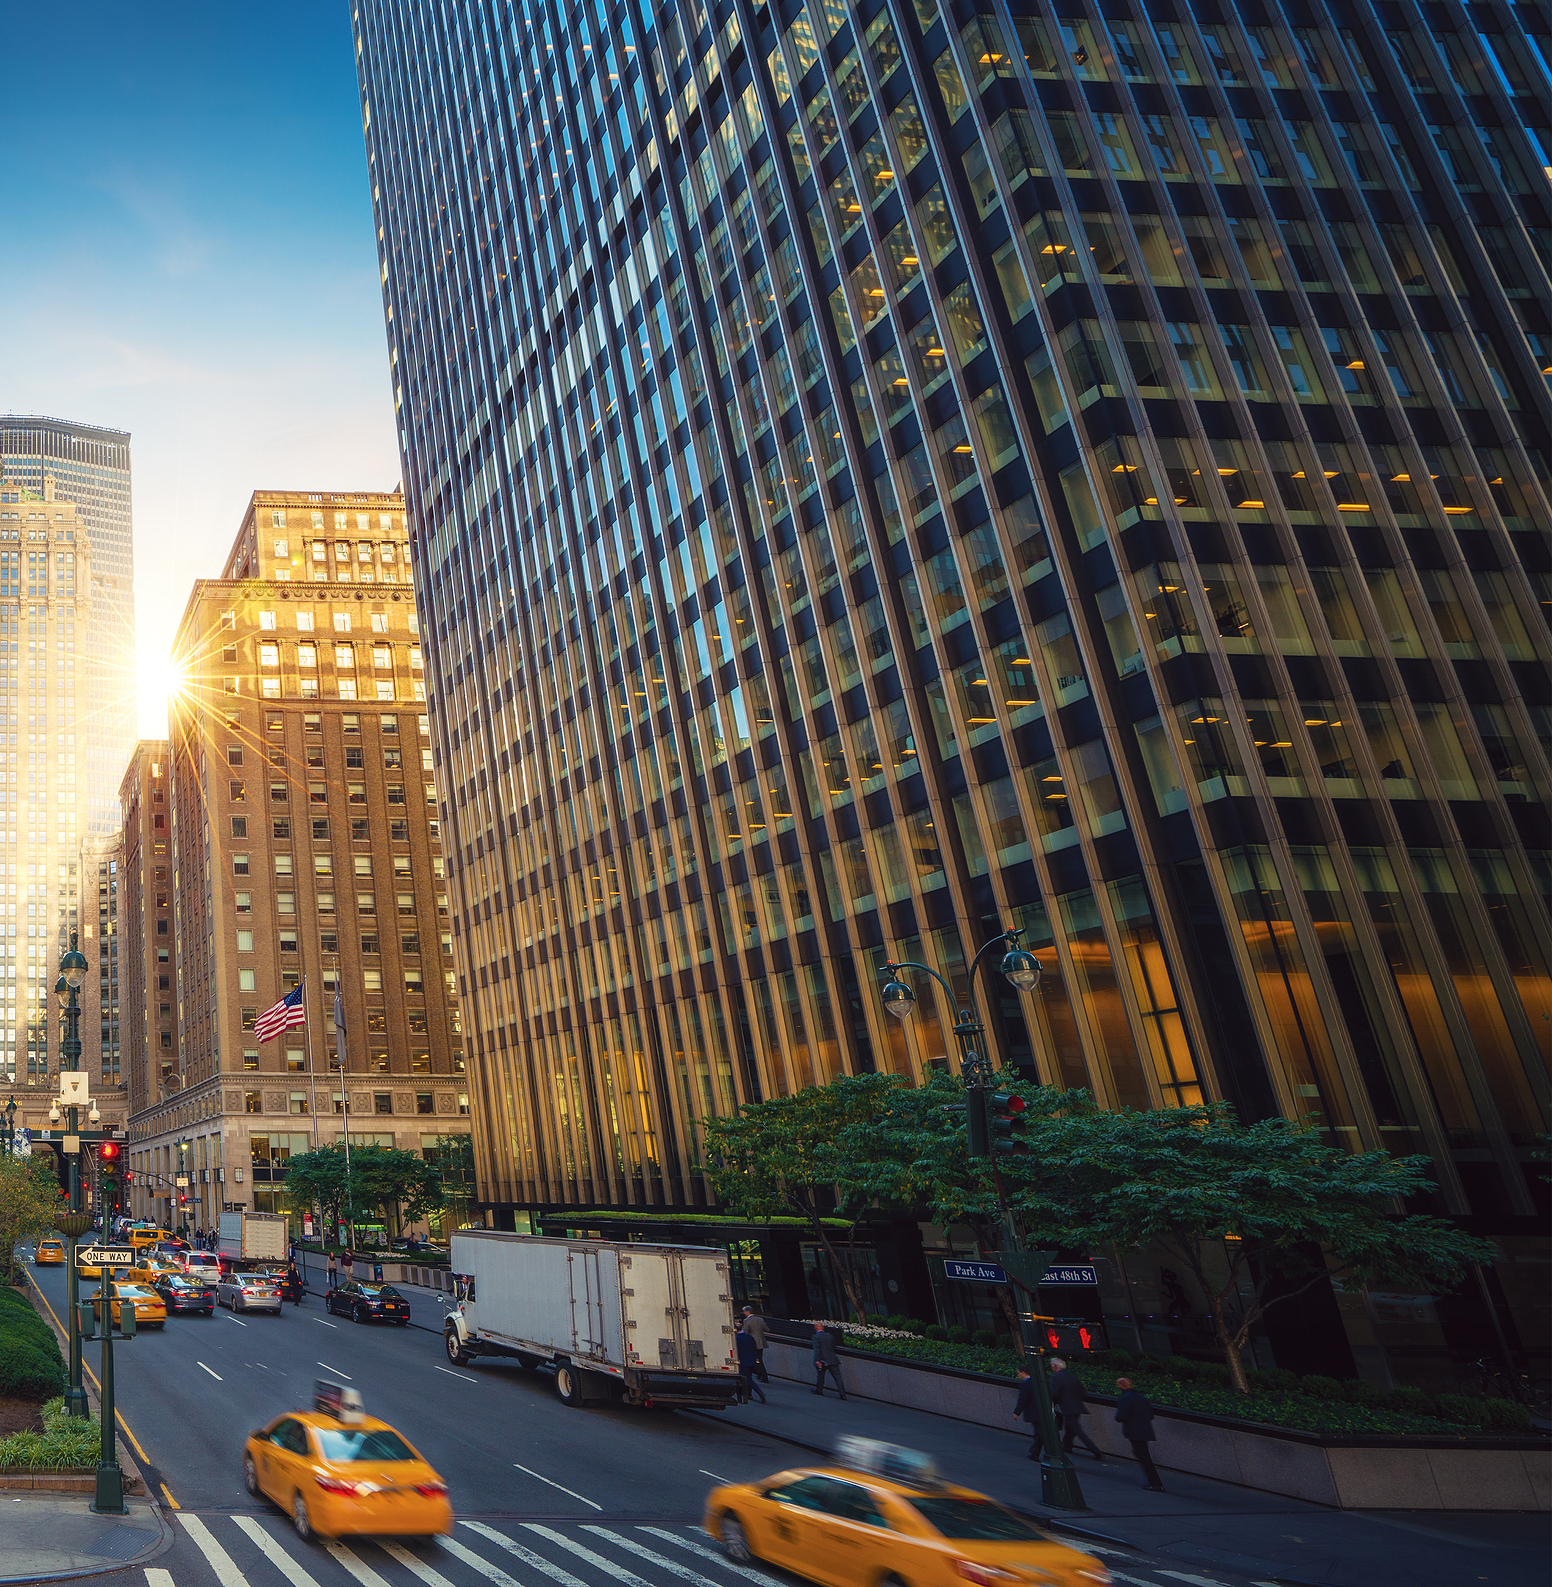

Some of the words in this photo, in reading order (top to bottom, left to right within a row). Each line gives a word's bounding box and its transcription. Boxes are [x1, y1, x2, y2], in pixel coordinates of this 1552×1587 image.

[86, 1252, 105, 1261] ONE
[109, 1253, 128, 1261] WAY
[954, 1264, 977, 1277] Park
[978, 1266, 996, 1278] Ave
[1041, 1271, 1059, 1281] ast
[1060, 1270, 1080, 1281] 48th
[1081, 1270, 1093, 1281] St
